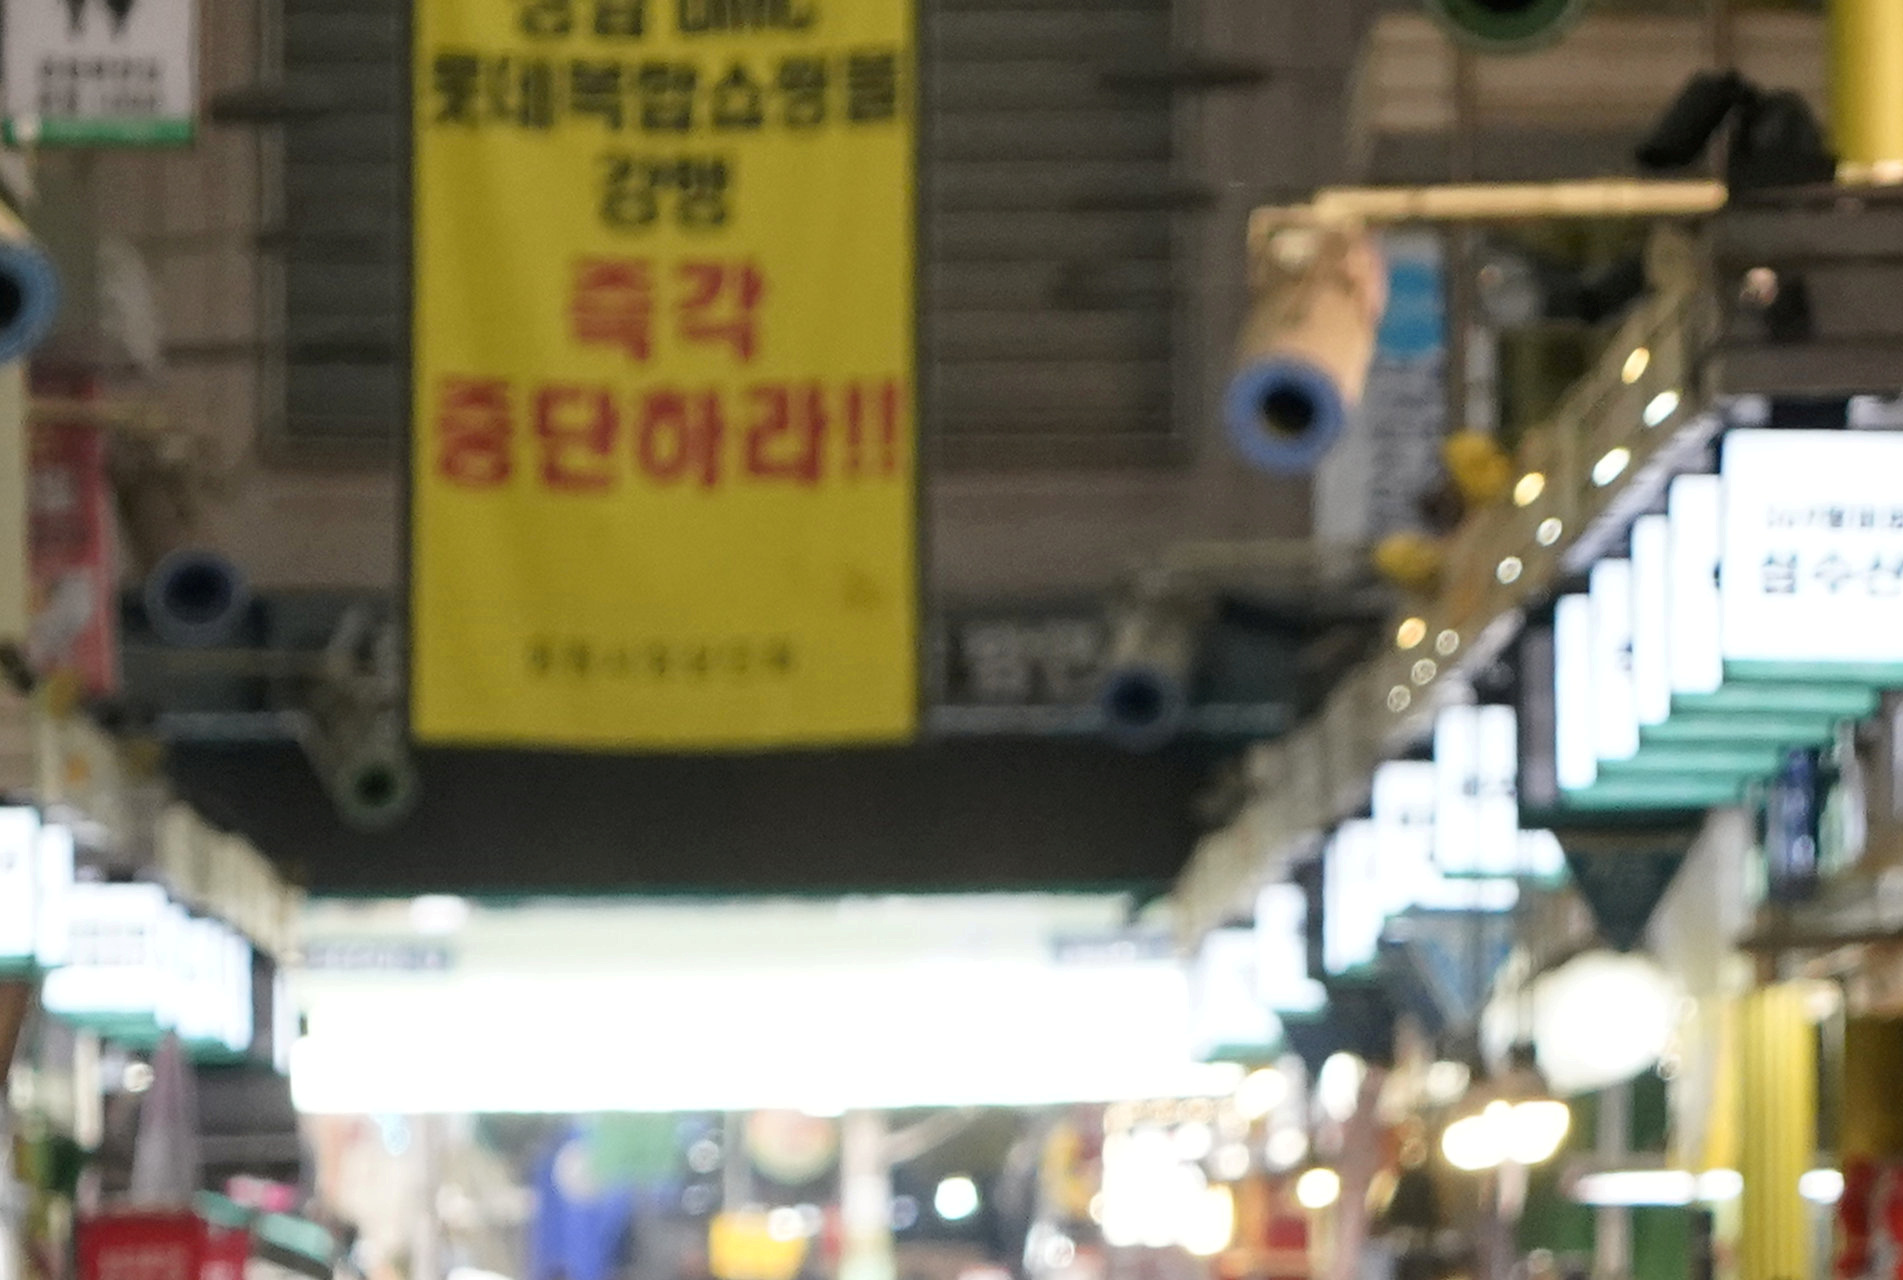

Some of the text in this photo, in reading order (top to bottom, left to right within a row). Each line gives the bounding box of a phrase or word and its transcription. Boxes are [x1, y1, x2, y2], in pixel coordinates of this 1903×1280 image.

[601, 152, 729, 228] 강행
[571, 258, 766, 362] 즉각
[438, 375, 900, 490] 중단하라!!
